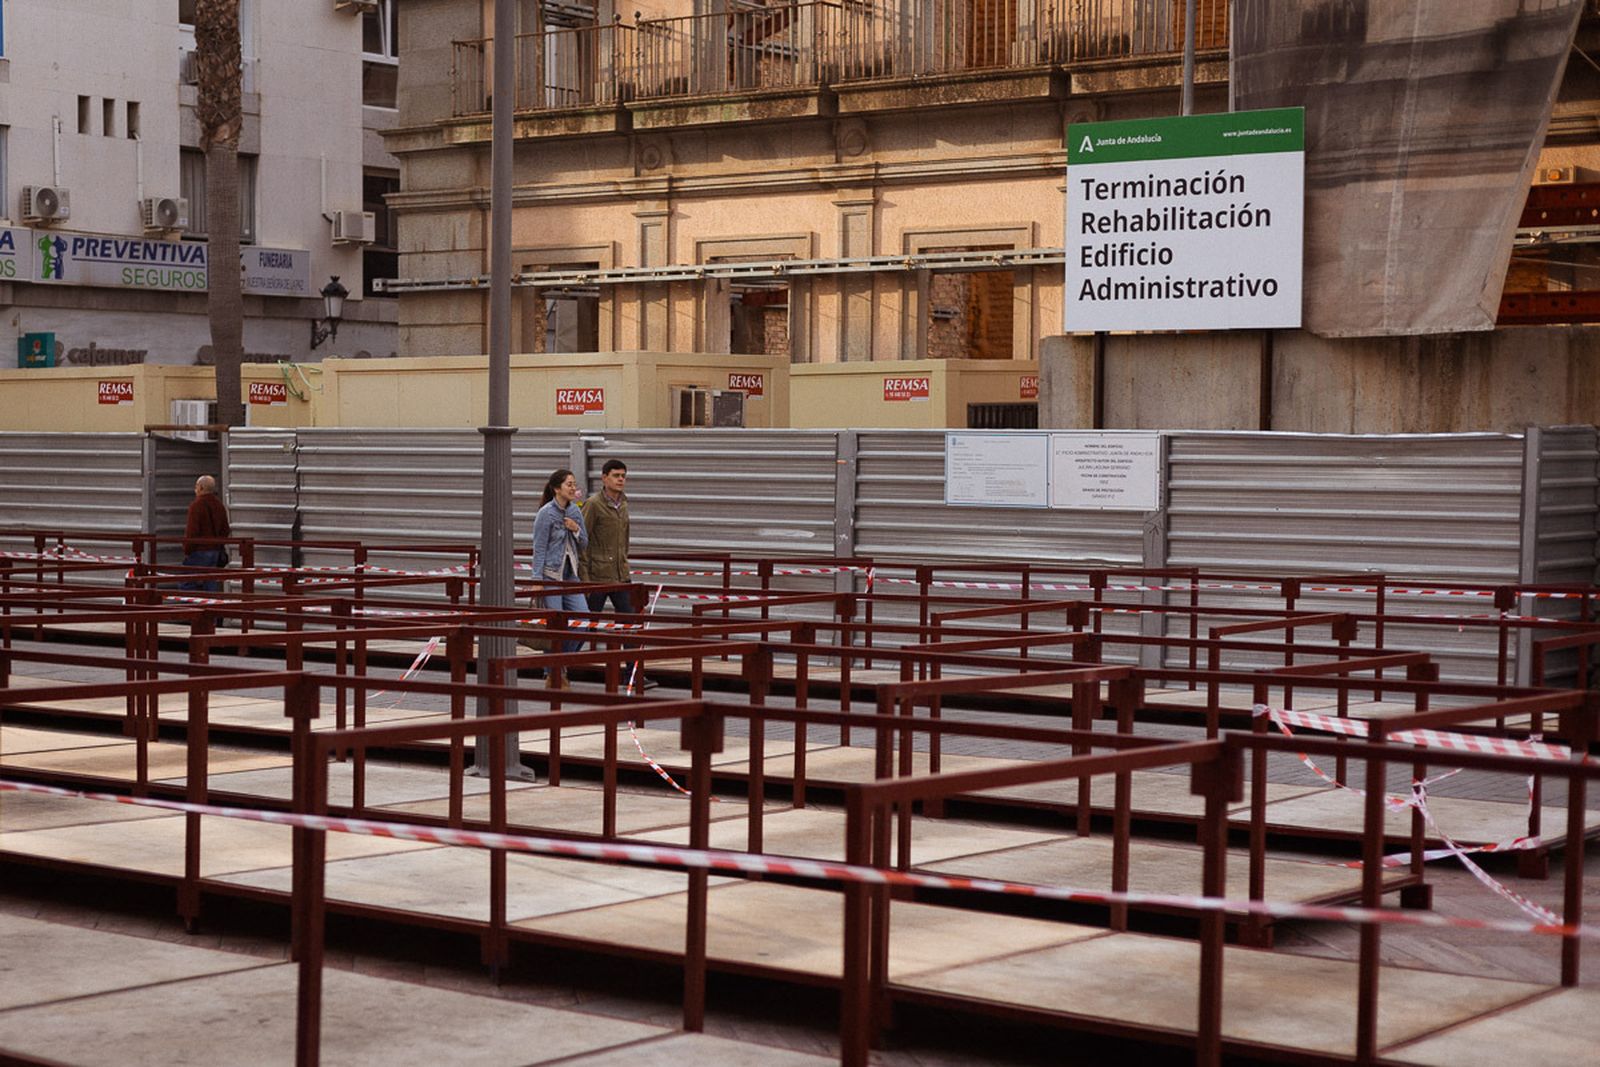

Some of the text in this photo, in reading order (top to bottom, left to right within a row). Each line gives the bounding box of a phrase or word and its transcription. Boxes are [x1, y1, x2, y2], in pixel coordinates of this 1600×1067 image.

[1096, 133, 1163, 147] Junta de Andalucía
[1222, 127, 1292, 138] www.juntadeandalucia.es
[1081, 169, 1246, 201] Terminación
[1081, 202, 1272, 234] Rehabilitación
[72, 237, 206, 264] PREVENTIVA
[1080, 242, 1174, 267] Edificio
[259, 252, 293, 270] FUNERARIA
[122, 267, 206, 289] SEGUROS
[1078, 273, 1279, 301] Administrativo
[67, 342, 148, 365] cajamar
[99, 383, 133, 395] REMSA
[730, 375, 762, 388] REMSA
[885, 379, 928, 391] REMSA
[1020, 377, 1039, 389] REM
[250, 384, 286, 396] REMSA
[558, 390, 603, 403] REMSA
